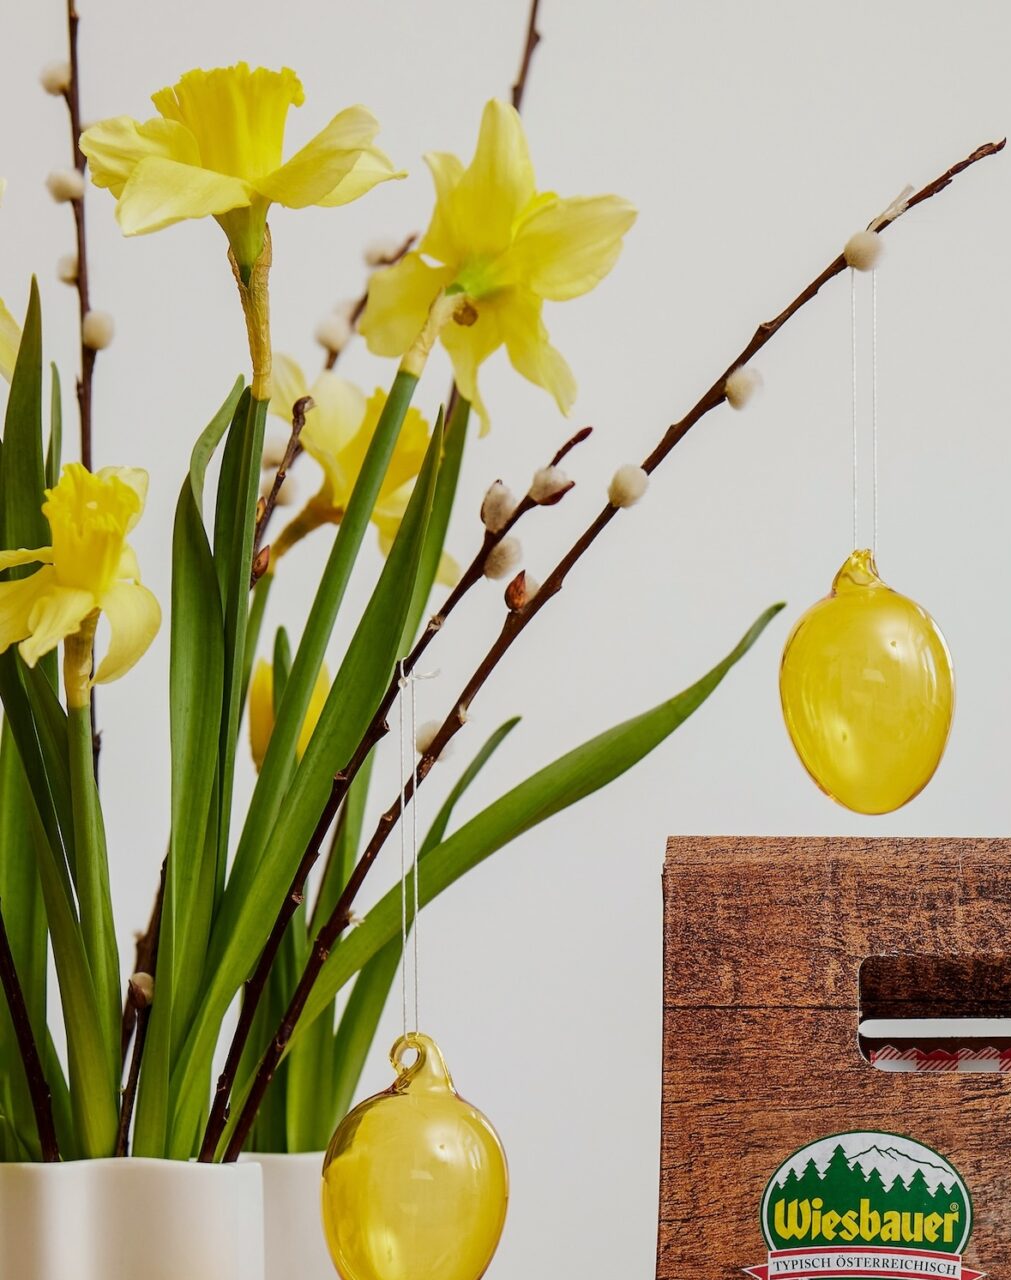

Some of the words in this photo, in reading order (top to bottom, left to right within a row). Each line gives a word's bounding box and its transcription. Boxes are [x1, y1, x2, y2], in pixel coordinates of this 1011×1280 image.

[774, 1197, 959, 1243] Wiesbauer
[773, 1257, 831, 1272] TYPISCH
[836, 1254, 957, 1276] ÖSTERREICHISCH
